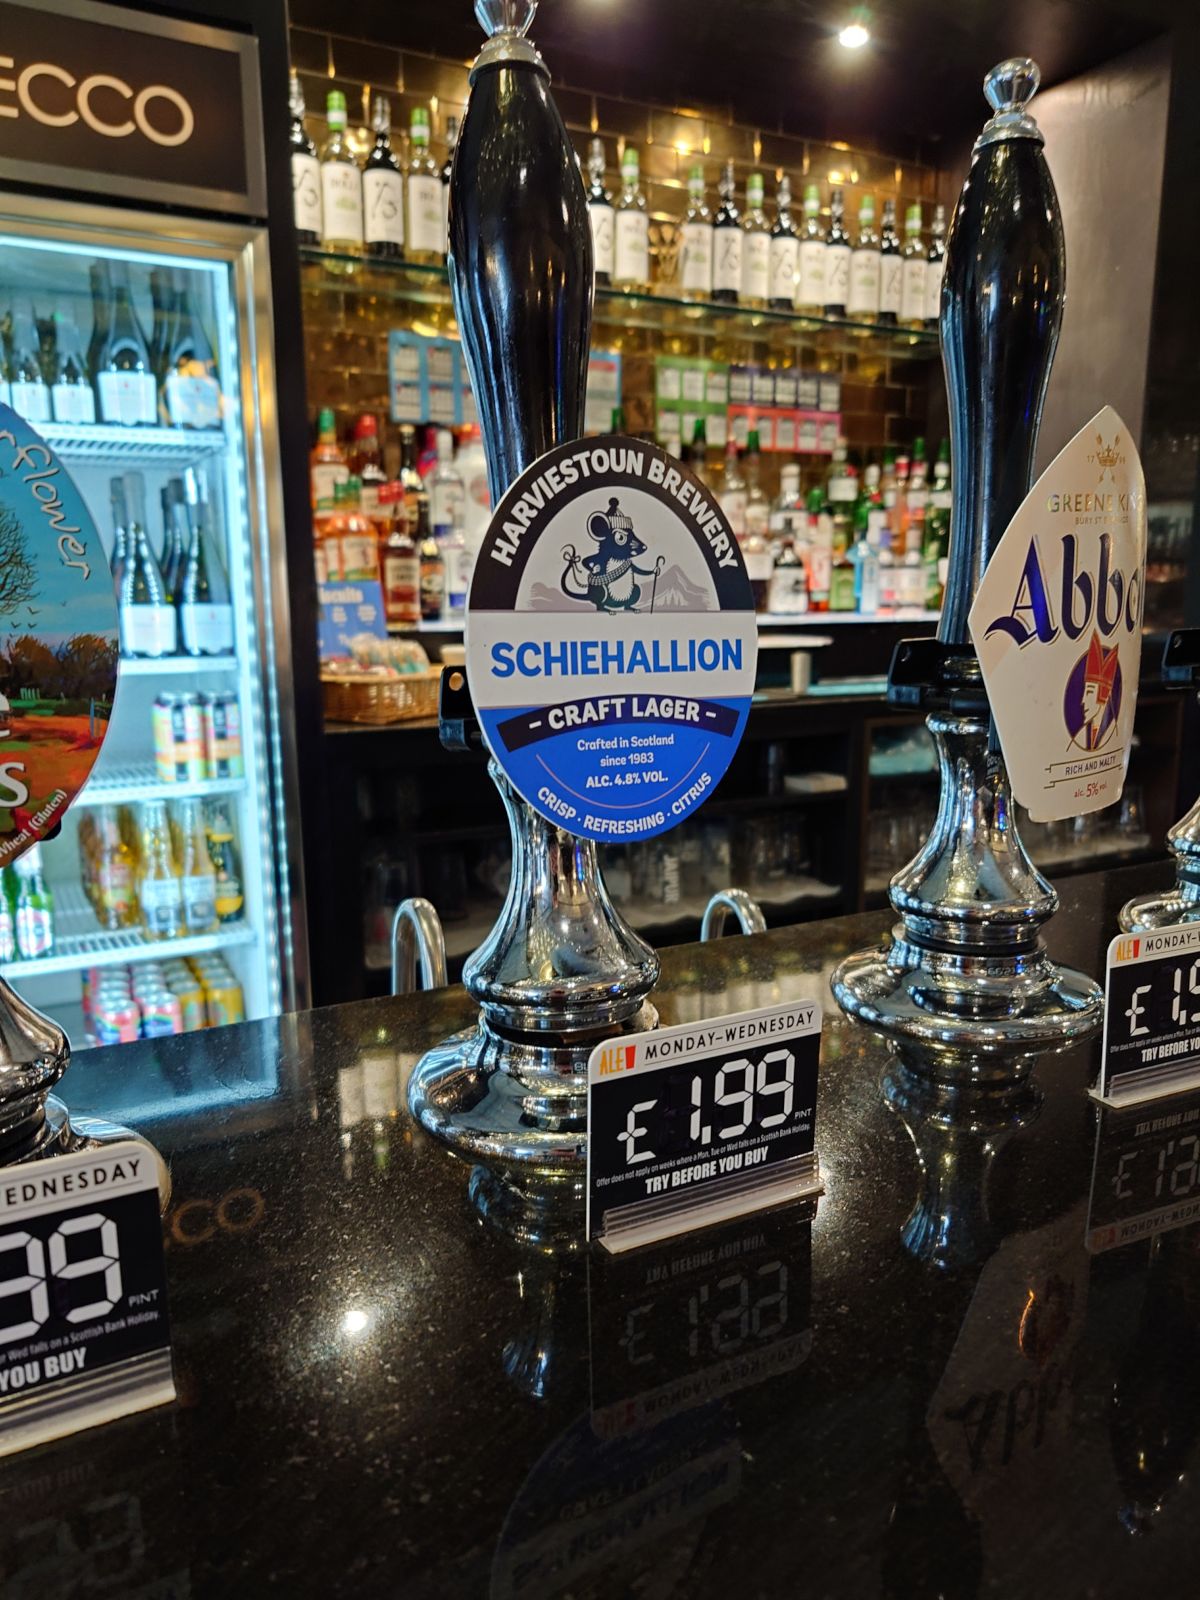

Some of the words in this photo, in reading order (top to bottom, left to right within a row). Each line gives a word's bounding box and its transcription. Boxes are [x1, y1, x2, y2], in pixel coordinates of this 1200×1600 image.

[490, 448, 645, 568] HARVIESTOUN
[648, 457, 739, 570] BREWERY
[1047, 493, 1113, 513] GREENE
[490, 638, 743, 677] SCHIEHALLION
[547, 698, 627, 731] CRAFT
[631, 697, 700, 723] LAGER
[577, 737, 618, 752] Crafted
[619, 736, 629, 748] in
[631, 733, 675, 748] Scotland
[600, 754, 625, 767] since
[627, 752, 654, 766] 1983
[1065, 765, 1083, 776] RICH
[1084, 762, 1098, 772] AND
[1099, 755, 1117, 769] MALTY
[585, 774, 613, 789] ALC.
[614, 772, 641, 786] 4.8%
[643, 770, 669, 785] VOL.
[1086, 782, 1099, 798] 5%
[28, 788, 68, 832] (Gluten)
[537, 786, 577, 822] CRISP
[583, 811, 666, 835] REFRESHING
[671, 772, 713, 817] CITRUS
[1116, 940, 1132, 962] ALE
[1125, 984, 1152, 1036] £
[599, 1046, 625, 1076] ALE
[1141, 1047, 1158, 1062] TRY
[1158, 1039, 1189, 1059] BEFORE
[616, 1099, 658, 1164] £
[689, 1049, 796, 1145] 1.99
[794, 1108, 812, 1120] PINT
[596, 1177, 610, 1187] Offer
[611, 1174, 625, 1184] does
[625, 1170, 635, 1180] not
[635, 1166, 651, 1180] apply
[651, 1163, 659, 1172] on
[659, 1159, 676, 1171] weeks
[676, 1155, 693, 1166] where
[711, 1148, 720, 1156] Tue
[720, 1146, 726, 1154] or
[726, 1143, 738, 1152] Wed
[738, 1140, 749, 1148] falls
[760, 1131, 780, 1143] Scottish
[780, 1127, 792, 1138] Bank
[645, 1173, 671, 1194] TRY
[671, 1160, 717, 1188] BEFORE
[719, 1152, 743, 1174] YOU
[744, 1145, 769, 1166] BUY
[128, 1288, 159, 1308] PINT
[7, 1346, 29, 1362] Wed
[29, 1341, 50, 1355] falls
[50, 1338, 63, 1350] on
[63, 1336, 69, 1346] a
[69, 1325, 105, 1343] Scottish
[104, 1320, 126, 1334] Bank
[0, 1360, 41, 1392] YOU
[43, 1346, 87, 1379] BUY
